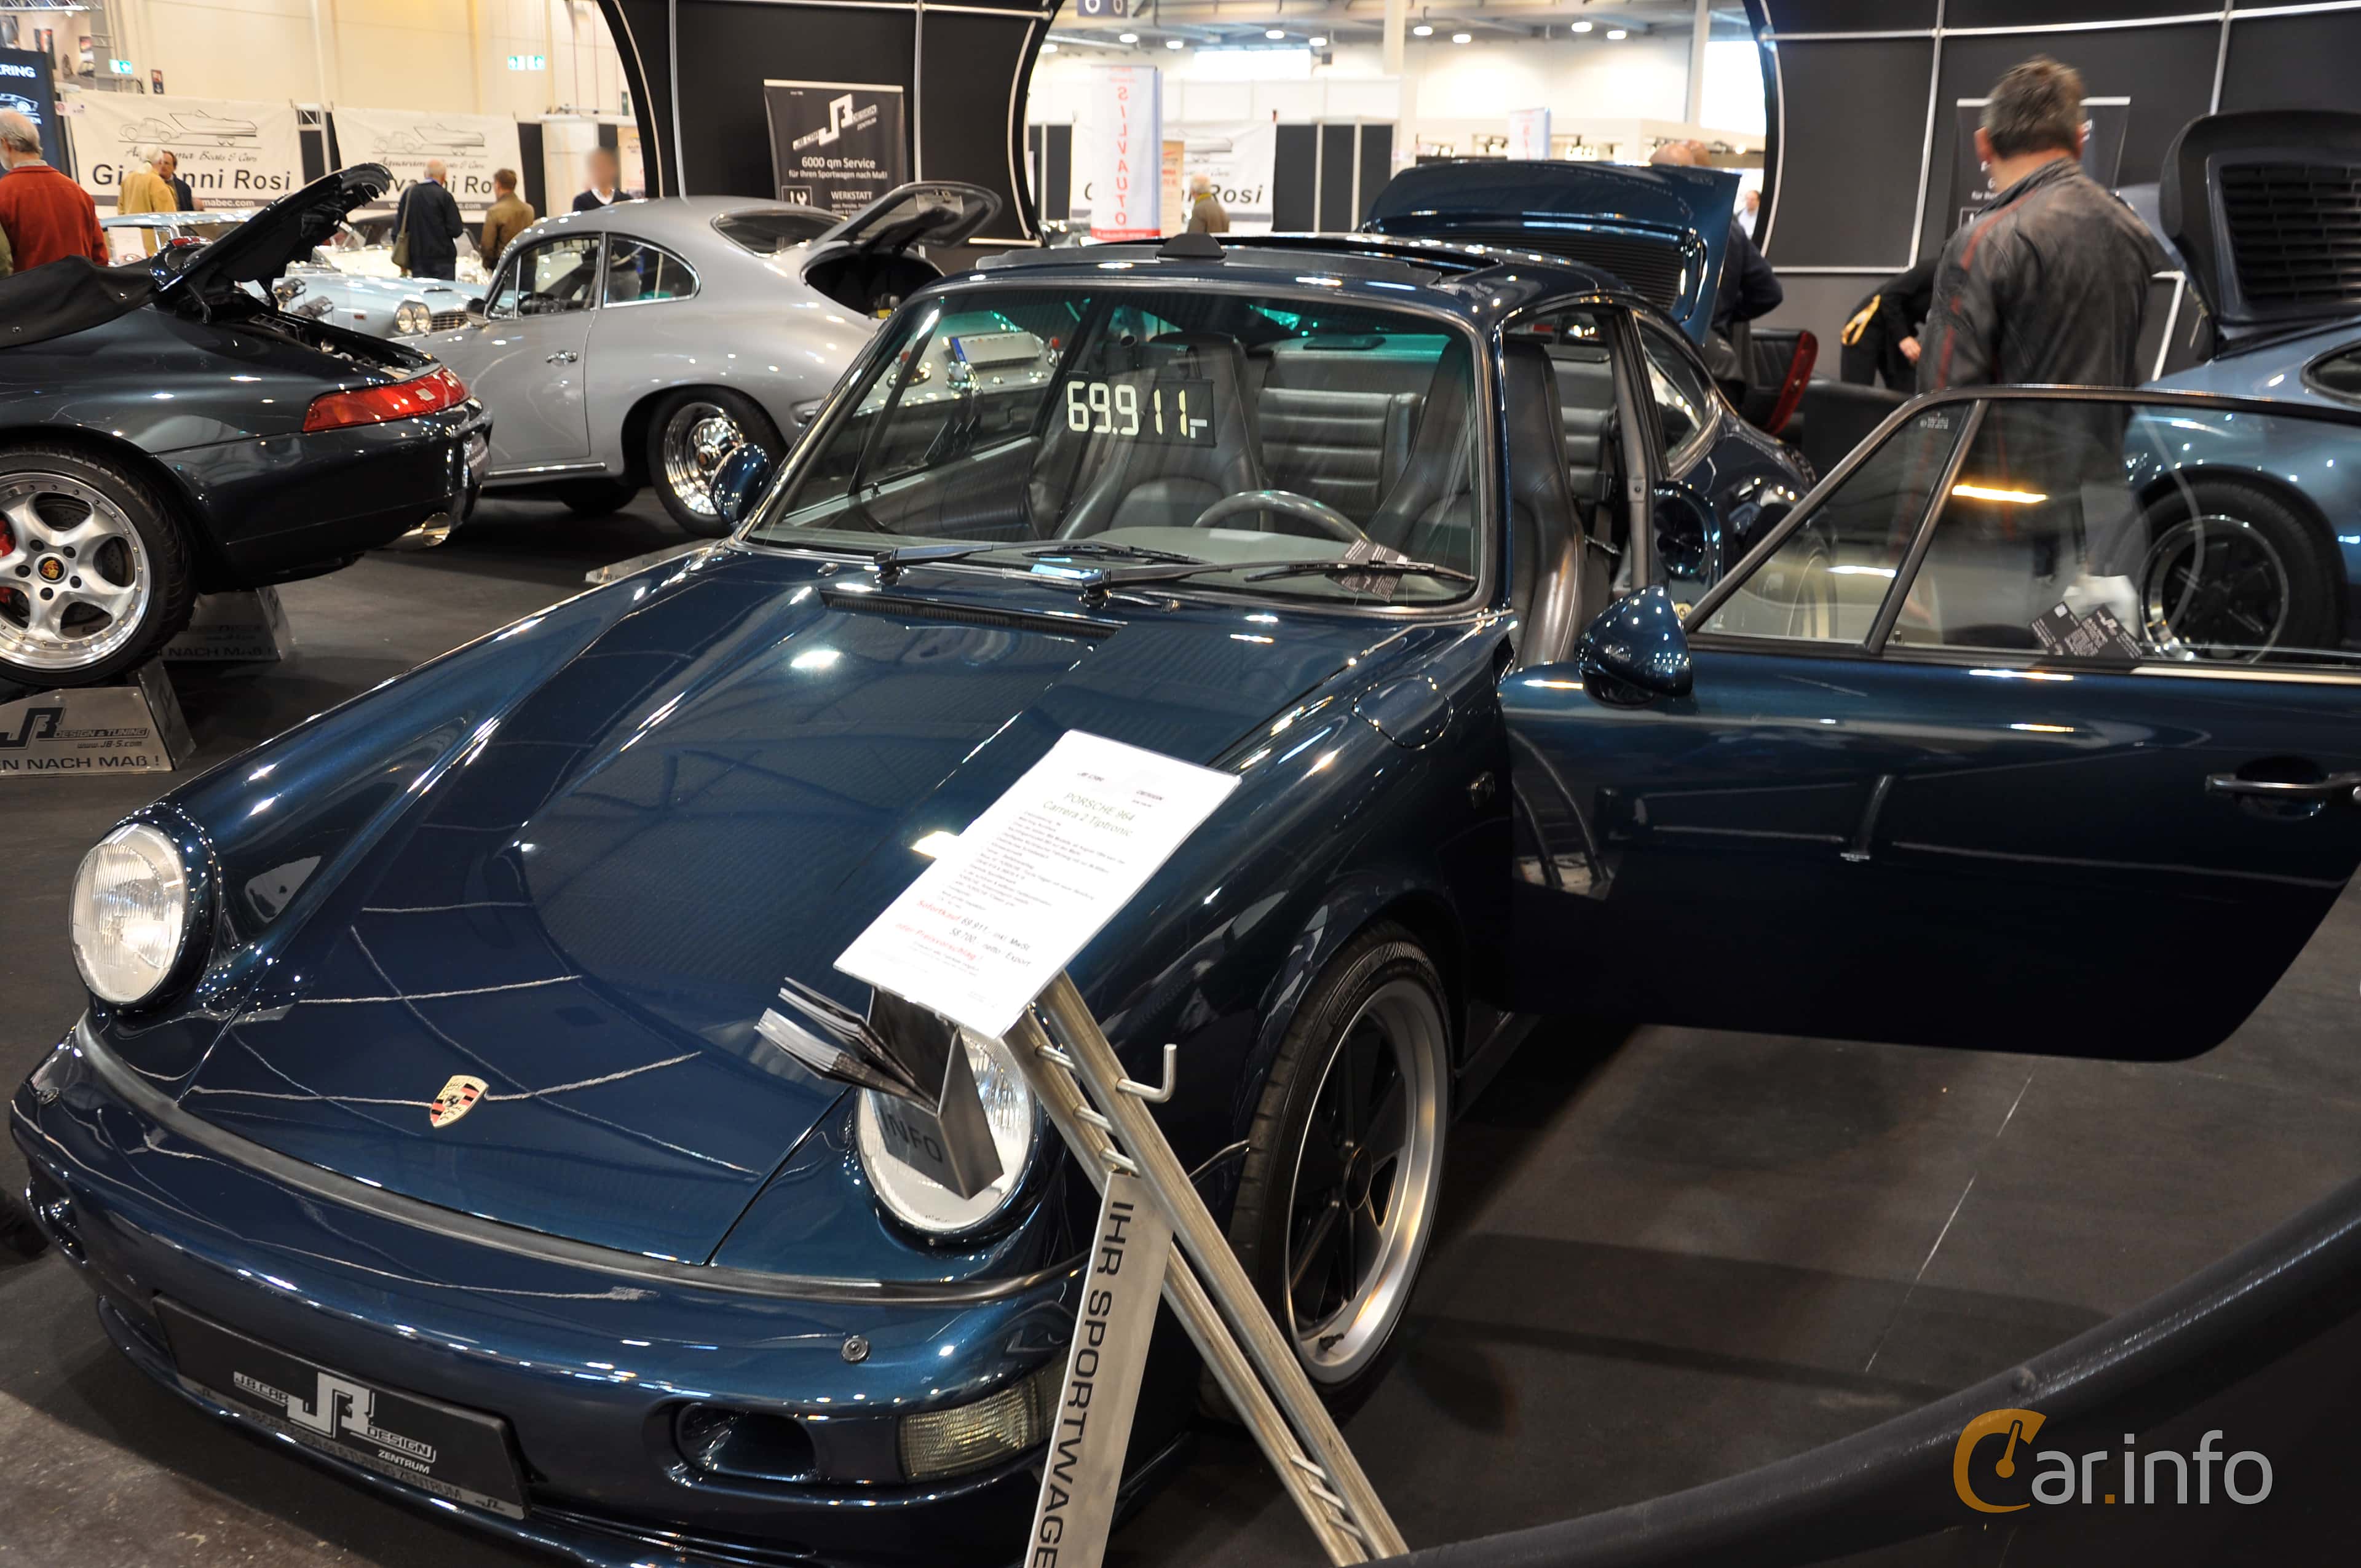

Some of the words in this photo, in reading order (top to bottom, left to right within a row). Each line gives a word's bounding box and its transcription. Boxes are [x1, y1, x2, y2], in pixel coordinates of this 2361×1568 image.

[0, 65, 36, 77] RING
[802, 156, 825, 168] 6000
[826, 159, 842, 170] qm
[843, 157, 876, 168] Service
[92, 164, 224, 188] Ginni
[234, 169, 291, 190] Rosi
[465, 175, 492, 194] Ro
[818, 170, 855, 180] Sportwagen
[856, 170, 871, 179] nach
[202, 197, 255, 208] mabec.com
[831, 191, 872, 200] WERKSTATT
[168, 647, 218, 657] NACH
[54, 729, 95, 738] DESIGN
[106, 728, 148, 737] TUNING
[26, 758, 91, 769] NACH
[1064, 791, 1116, 815] PORSCHE
[1115, 809, 1136, 822] 964
[1043, 801, 1079, 818] Carrera
[1079, 813, 1089, 822] 2
[1089, 815, 1133, 837] Tiptronic
[916, 899, 962, 921] Sofortkauf
[879, 1107, 943, 1164] INFO
[1096, 1200, 1135, 1277] IHR
[1032, 1289, 1113, 1568] SPORTWAGE
[367, 1425, 433, 1458] DESIGN
[378, 1448, 430, 1475] ZENTRUM
